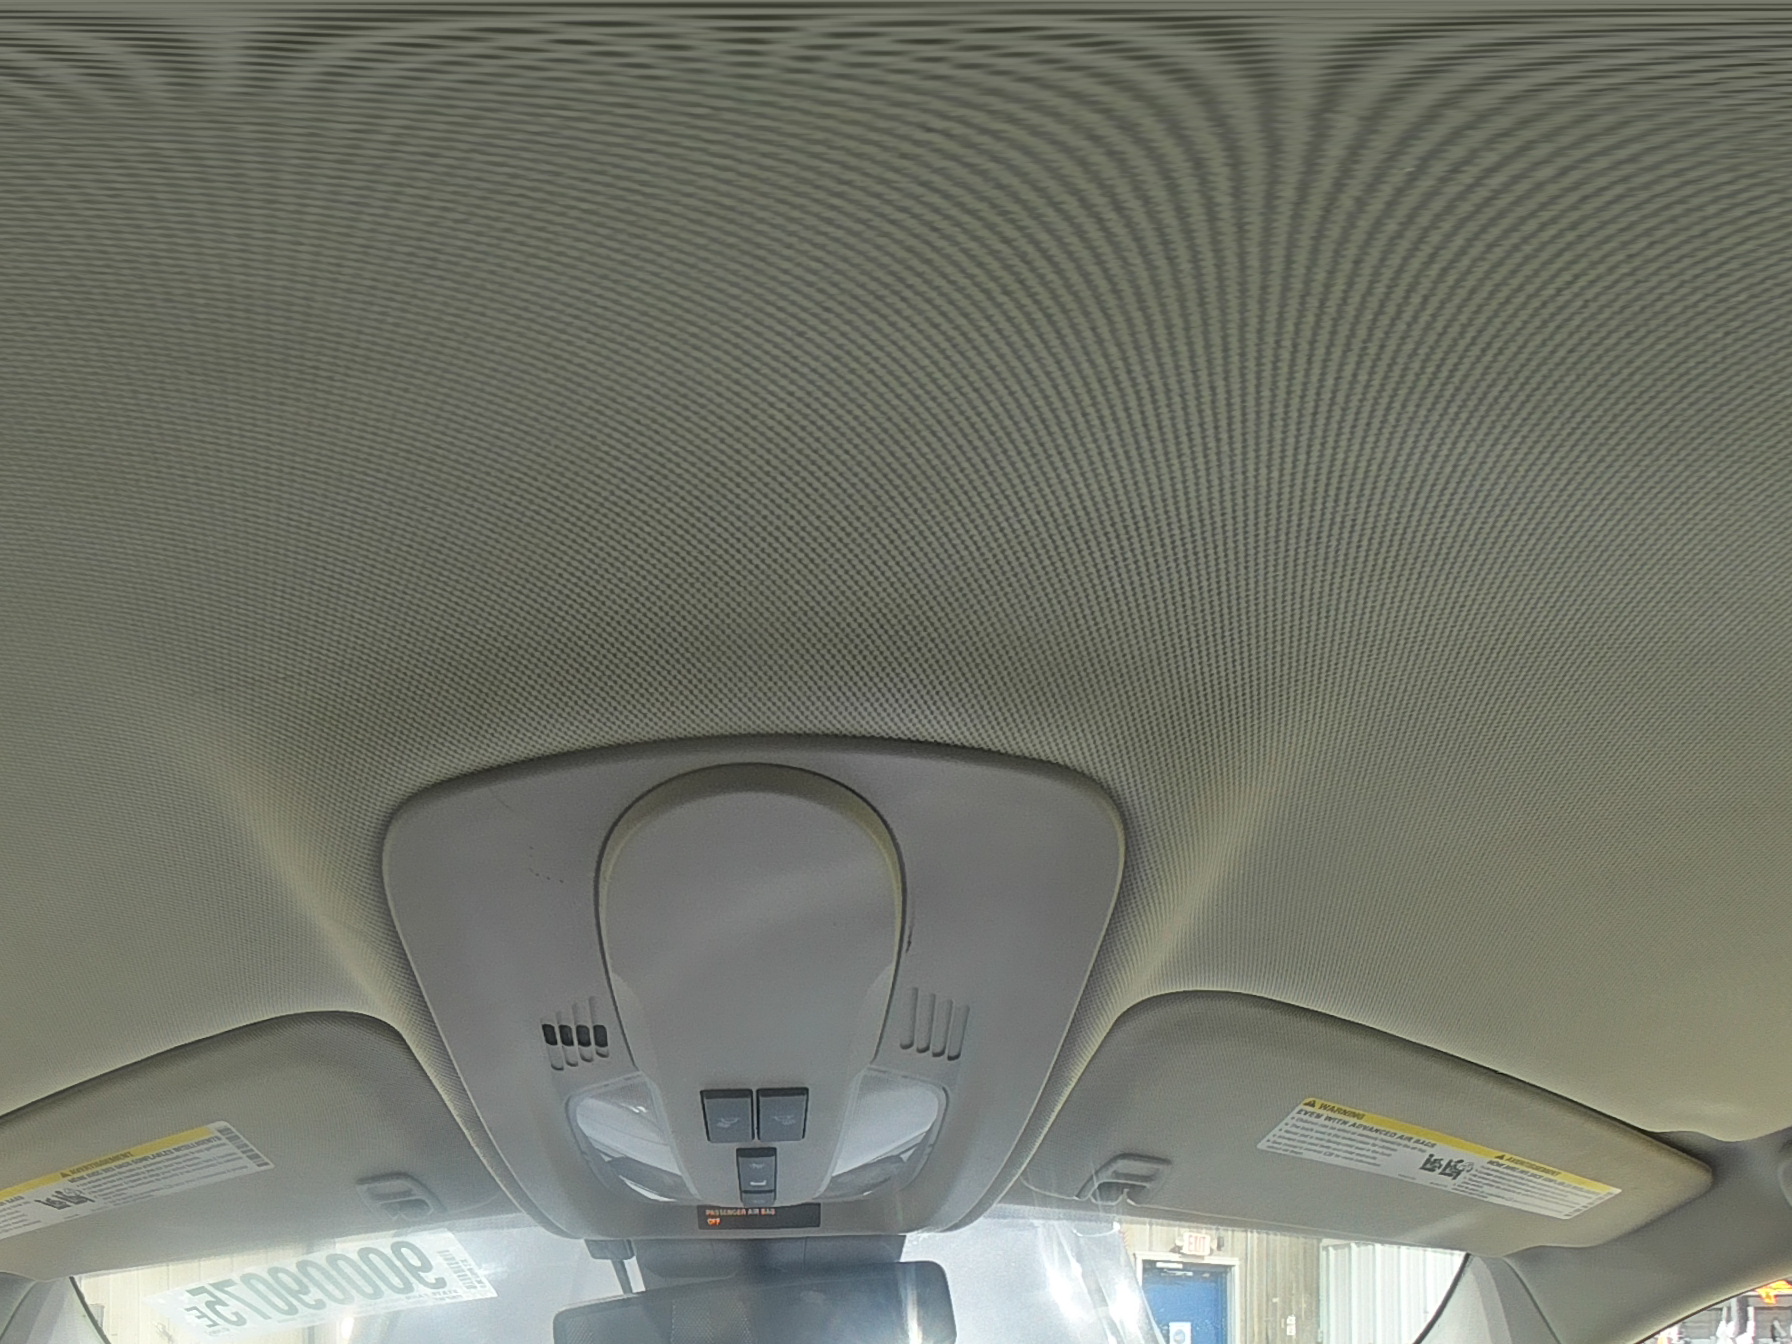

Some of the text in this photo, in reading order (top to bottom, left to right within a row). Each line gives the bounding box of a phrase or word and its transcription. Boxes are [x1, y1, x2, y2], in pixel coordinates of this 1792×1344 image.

[1316, 1101, 1366, 1120] WARNING
[1295, 1107, 1324, 1119] EVEN
[1323, 1115, 1350, 1126] WITH
[1348, 1120, 1398, 1138] ADVANCED
[1395, 1133, 1414, 1142] AIR
[1412, 1137, 1437, 1148] BAGS
[705, 1208, 747, 1217] PASSENGER
[761, 1208, 776, 1216] BAG
[707, 1217, 721, 1226] OFF
[1188, 1235, 1207, 1249] EXIT
